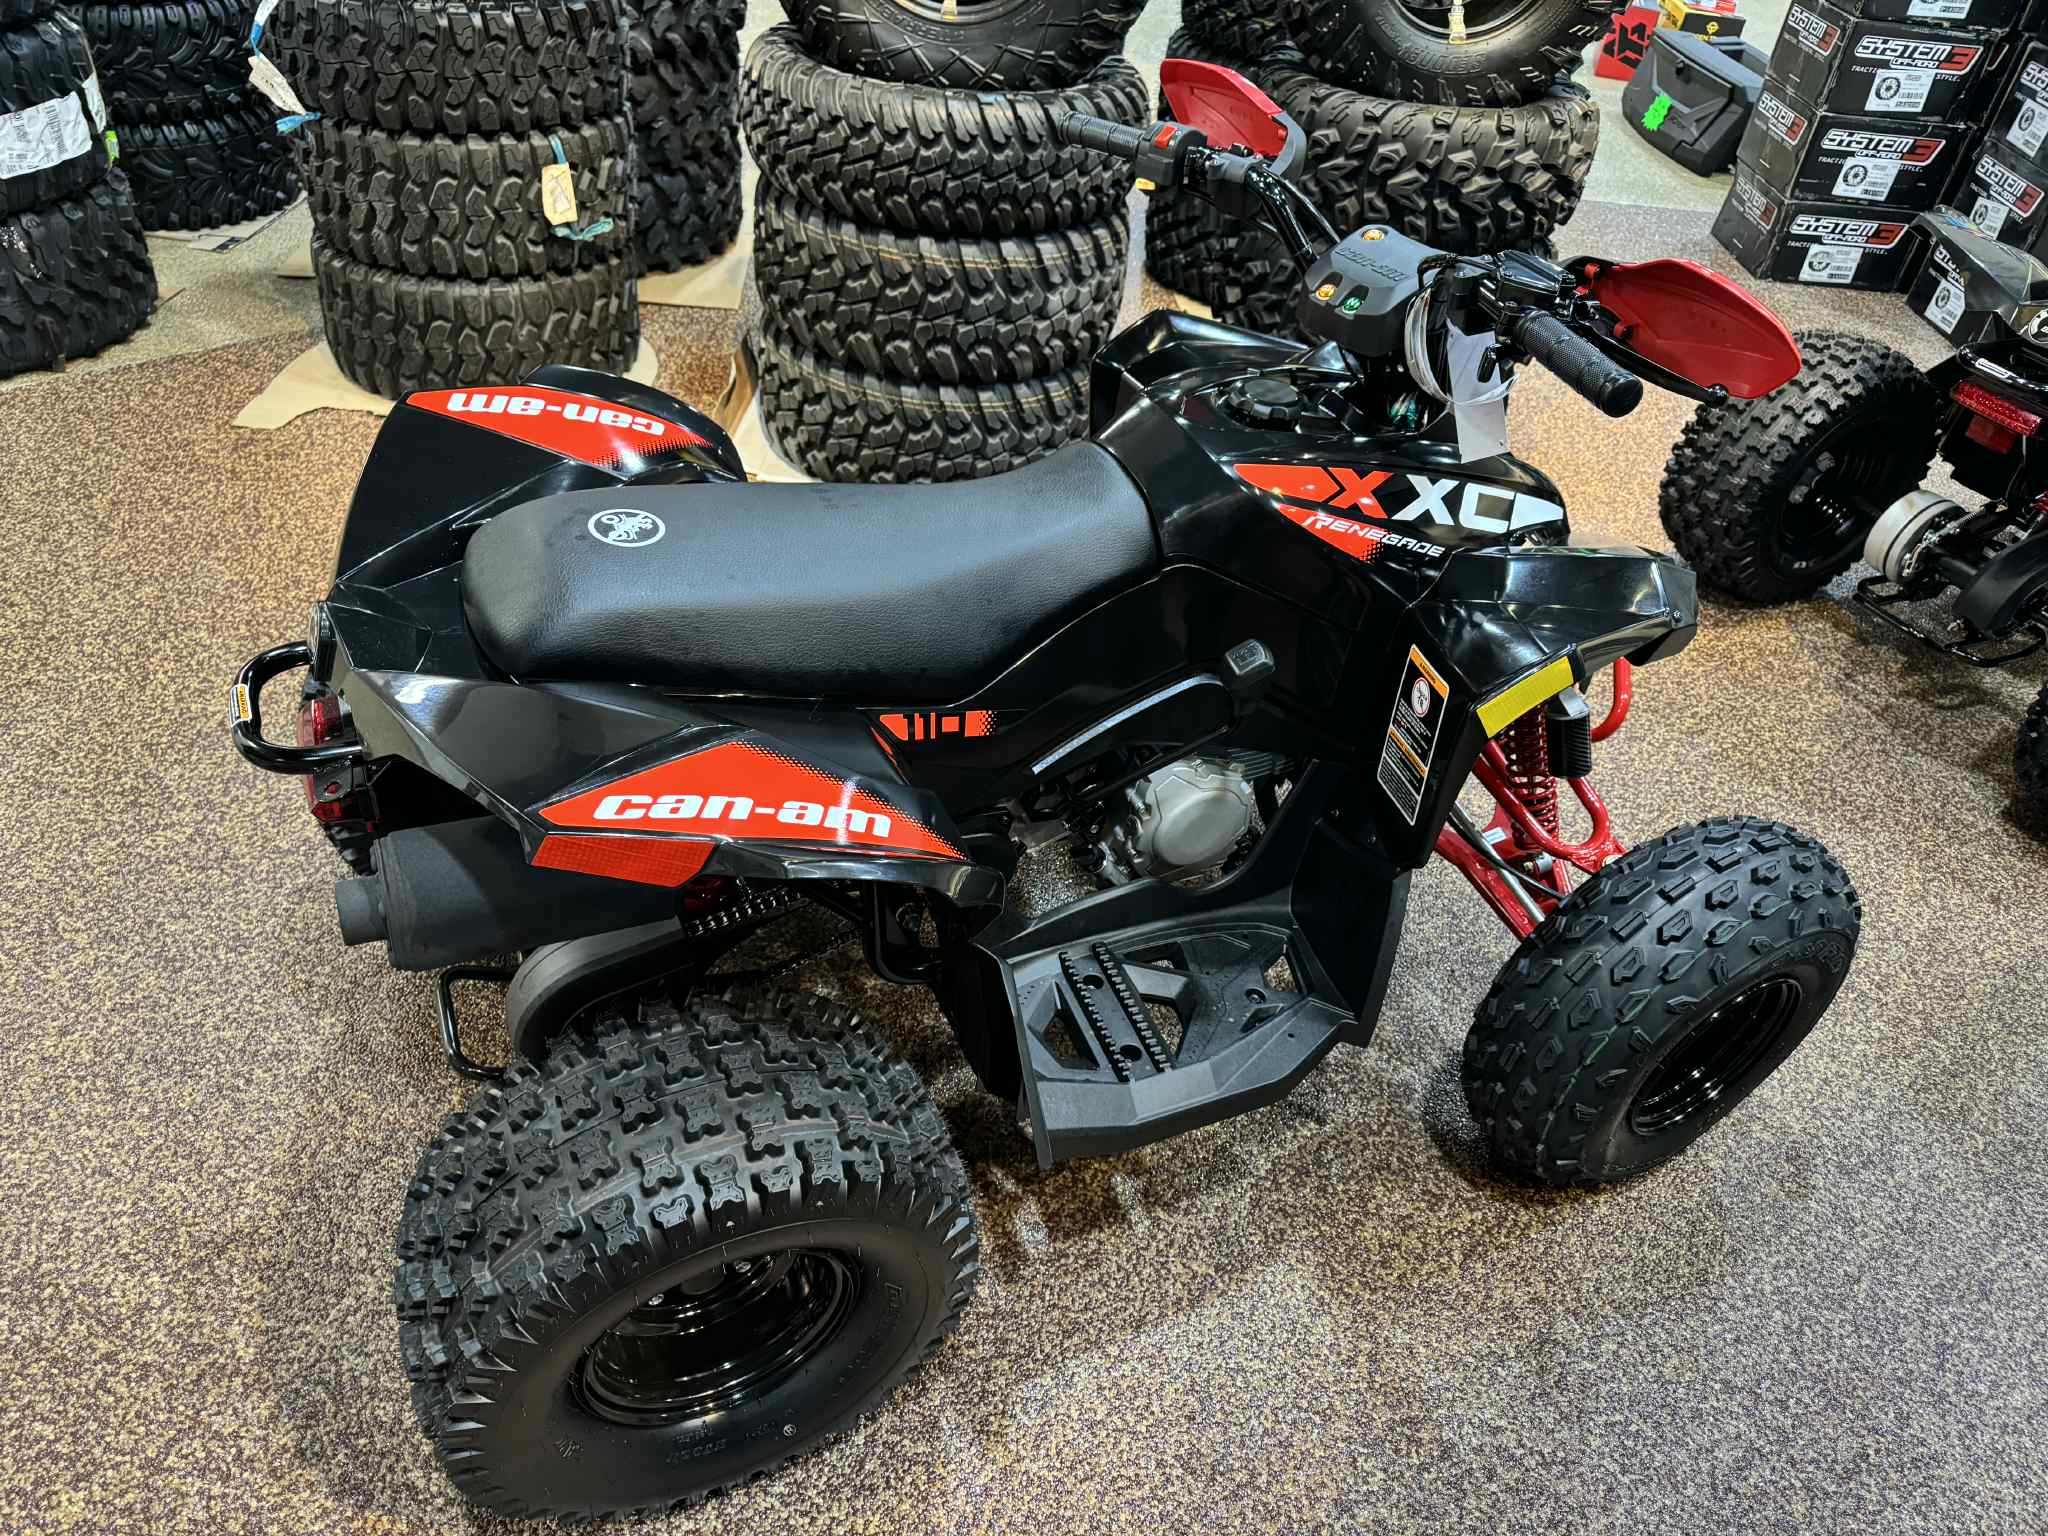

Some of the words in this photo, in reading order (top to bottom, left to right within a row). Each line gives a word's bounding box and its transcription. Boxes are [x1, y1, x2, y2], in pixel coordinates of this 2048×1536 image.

[1788, 6, 1827, 38] SYSTEM
[1851, 65, 1879, 74] TRACTI
[1857, 38, 1953, 61] SYSTEM
[1938, 47, 1981, 72] 3
[1891, 57, 1939, 69] OFF-ROAD
[2021, 63, 2048, 92] SYS
[1758, 93, 1795, 127] SYSTEM
[1822, 131, 1914, 153] SYSTEM
[1903, 139, 1942, 162] 3
[1857, 149, 1902, 159] OFF-ROAD
[1977, 157, 2027, 197] SYSTEM
[2014, 186, 2043, 214] 3
[1792, 217, 1879, 237] SYSTEM
[1867, 224, 1905, 246] 3
[1823, 234, 1868, 243] OFF-ROAD
[447, 392, 665, 436] can-am
[1301, 513, 1446, 559] RENEGADE
[592, 793, 891, 838] can-am
